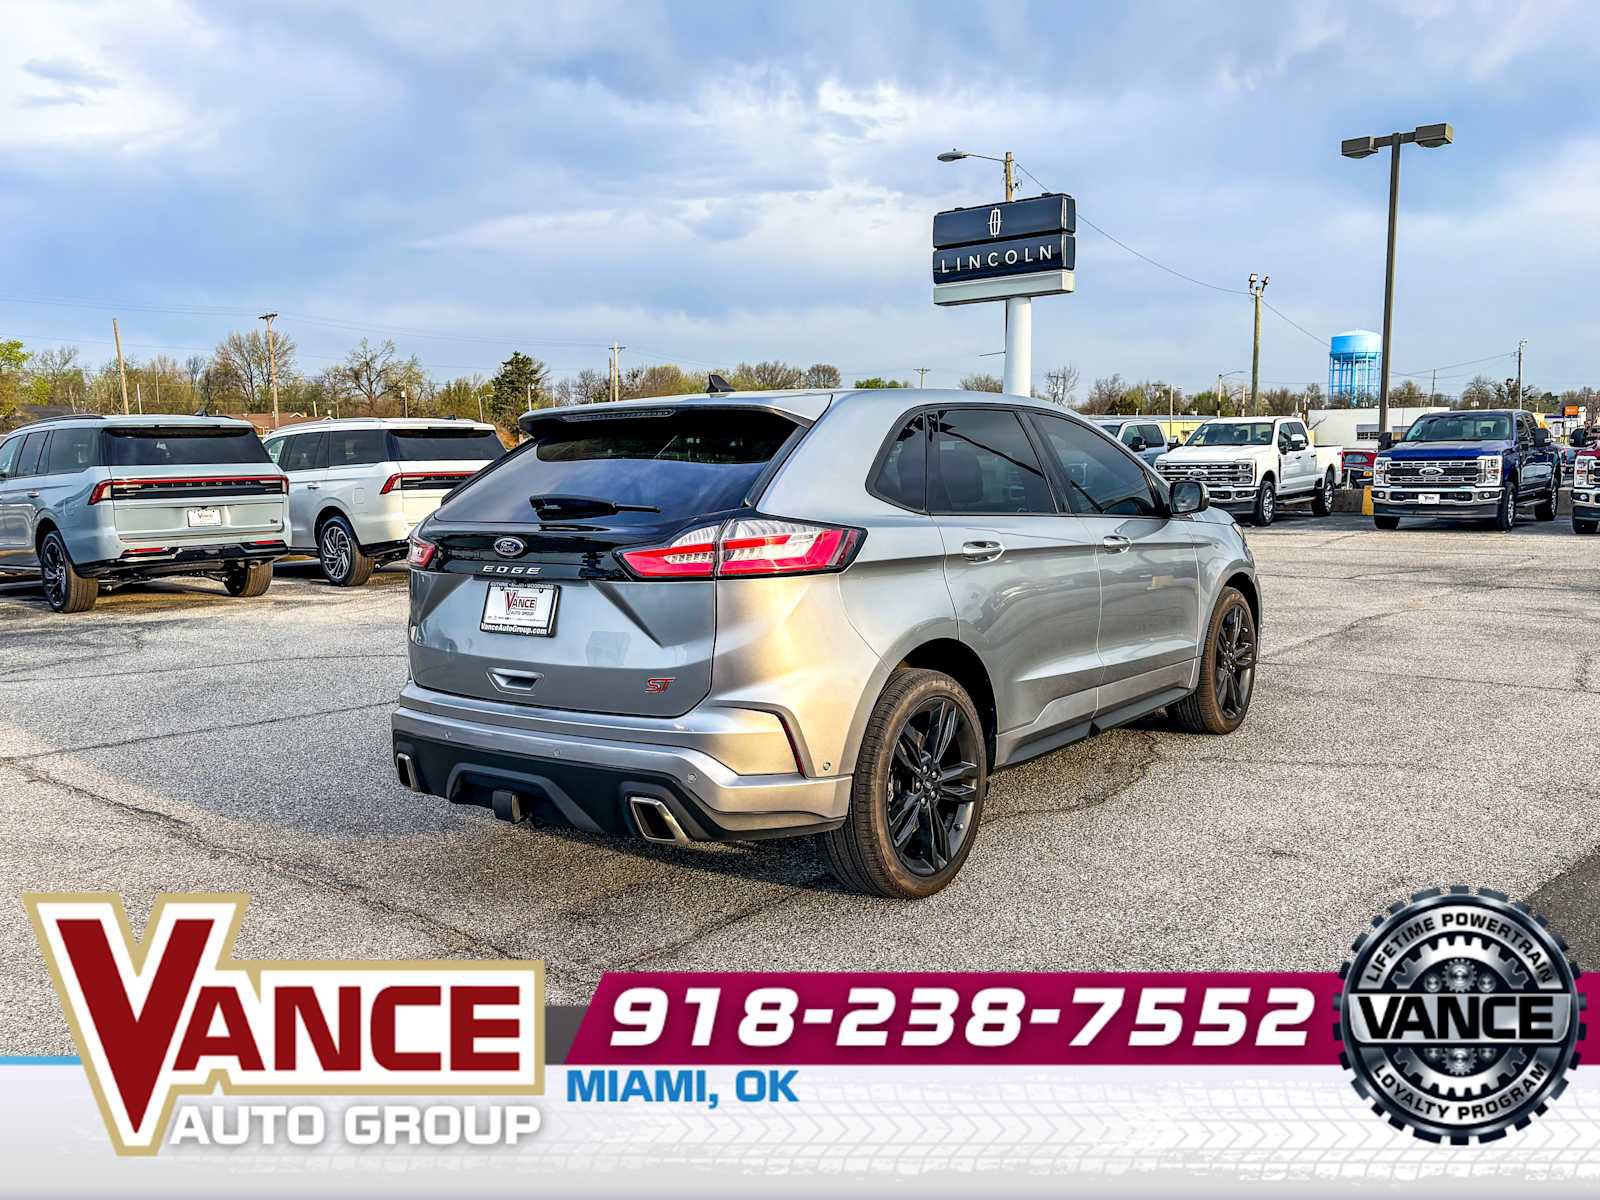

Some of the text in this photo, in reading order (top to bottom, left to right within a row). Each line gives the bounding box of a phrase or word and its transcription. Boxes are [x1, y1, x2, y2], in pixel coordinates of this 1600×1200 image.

[941, 245, 1052, 273] LINCOLN
[482, 565, 541, 575] EDGE
[505, 591, 536, 609] VANCE
[481, 622, 548, 635] VanceAutoGroup.com
[645, 677, 676, 694] ST
